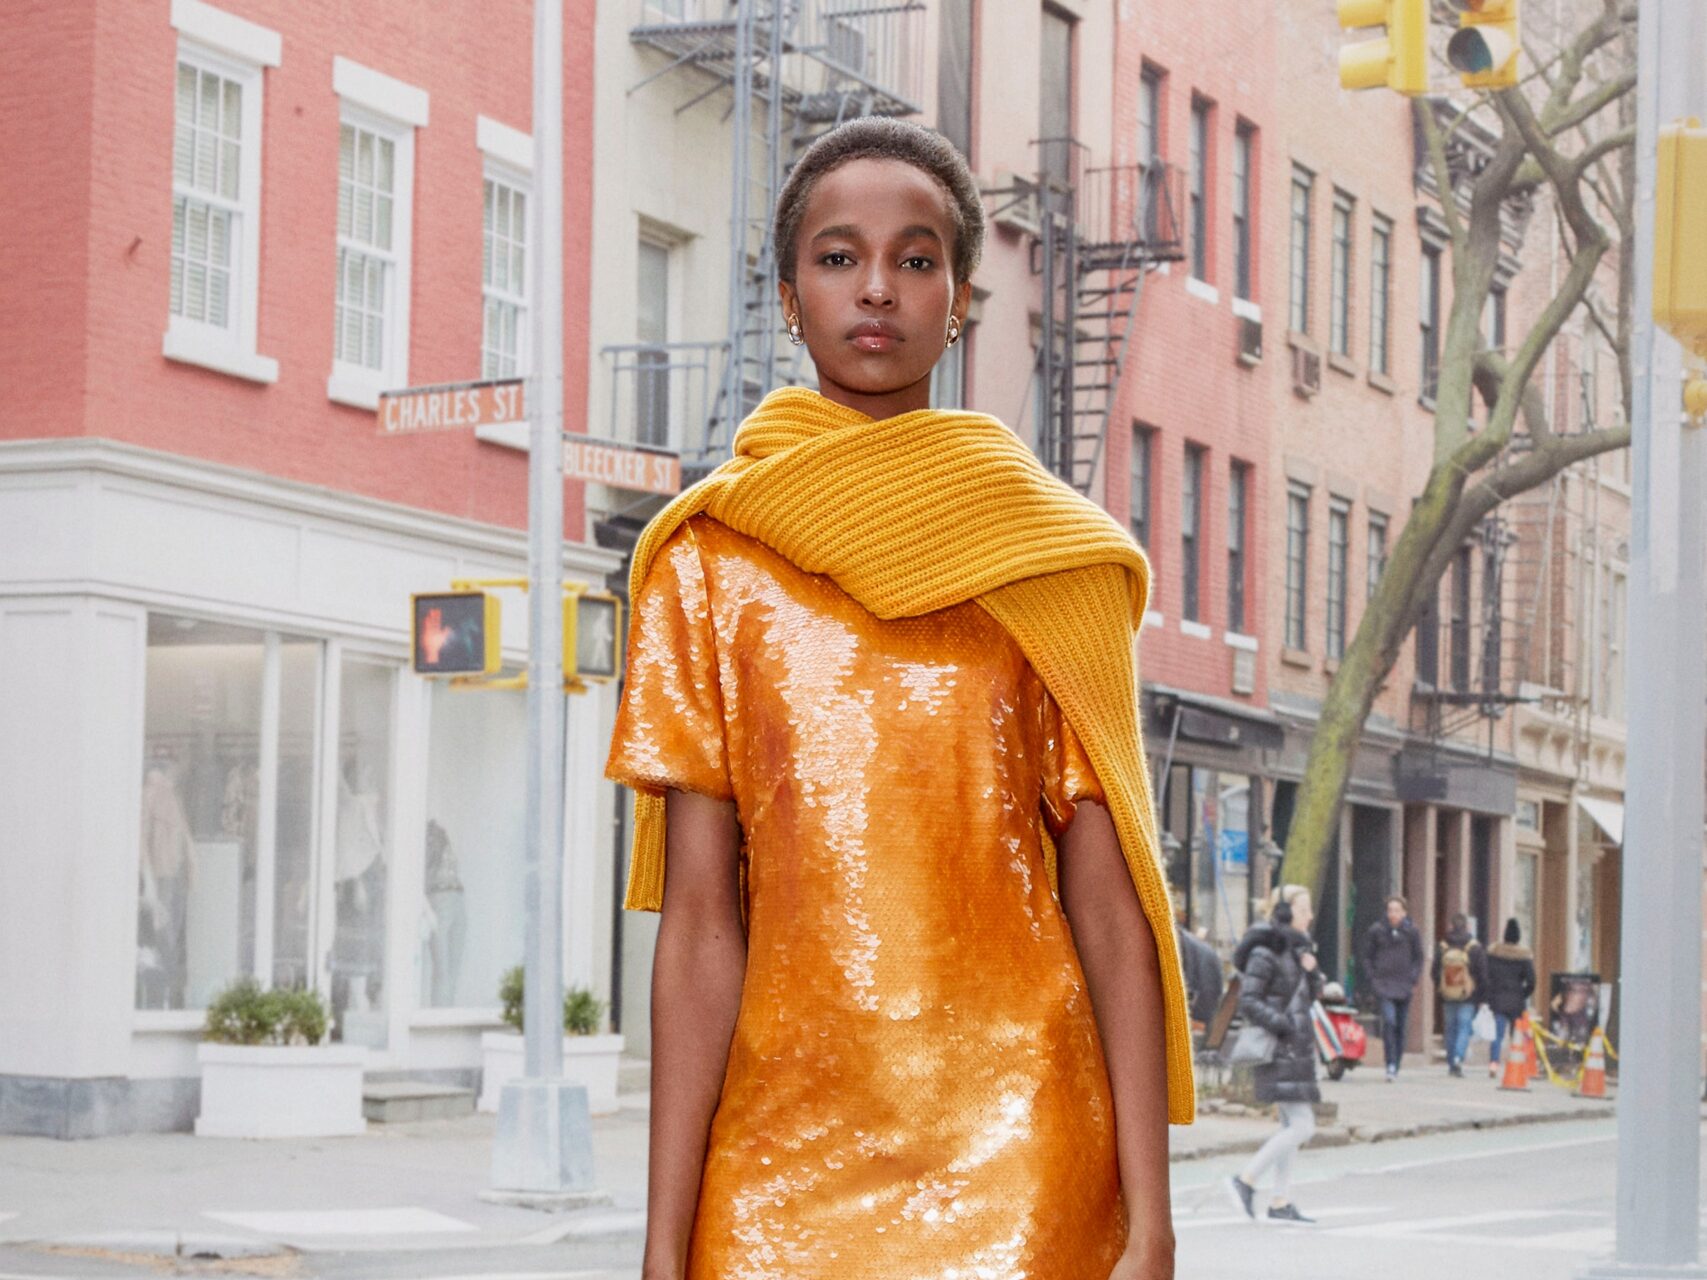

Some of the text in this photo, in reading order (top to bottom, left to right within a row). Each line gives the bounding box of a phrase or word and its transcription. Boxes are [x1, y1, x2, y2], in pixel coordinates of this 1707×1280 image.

[384, 384, 519, 432] CHARLES ST
[562, 441, 673, 490] BLEECKER ST
